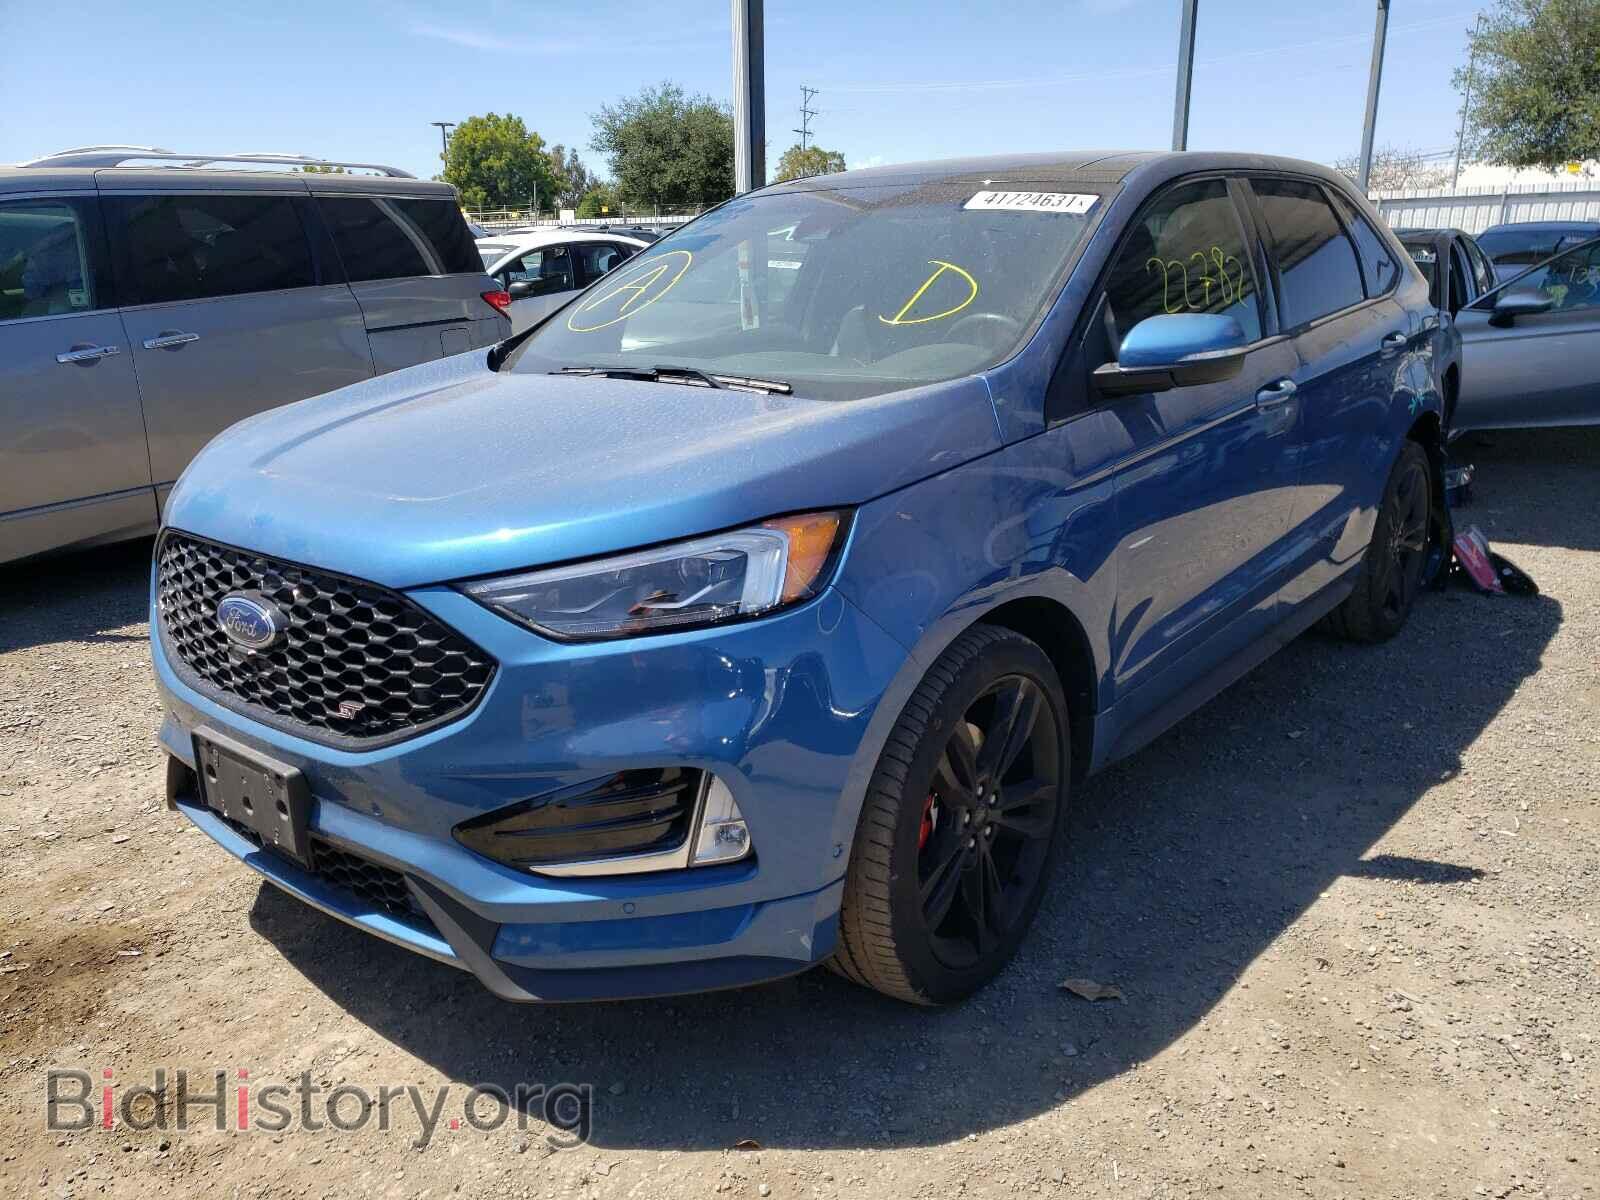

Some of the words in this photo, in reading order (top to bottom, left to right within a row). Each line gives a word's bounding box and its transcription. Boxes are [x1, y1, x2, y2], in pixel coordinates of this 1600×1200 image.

[983, 192, 1079, 208] 41724631
[878, 260, 978, 325] D
[226, 607, 258, 637] Ford
